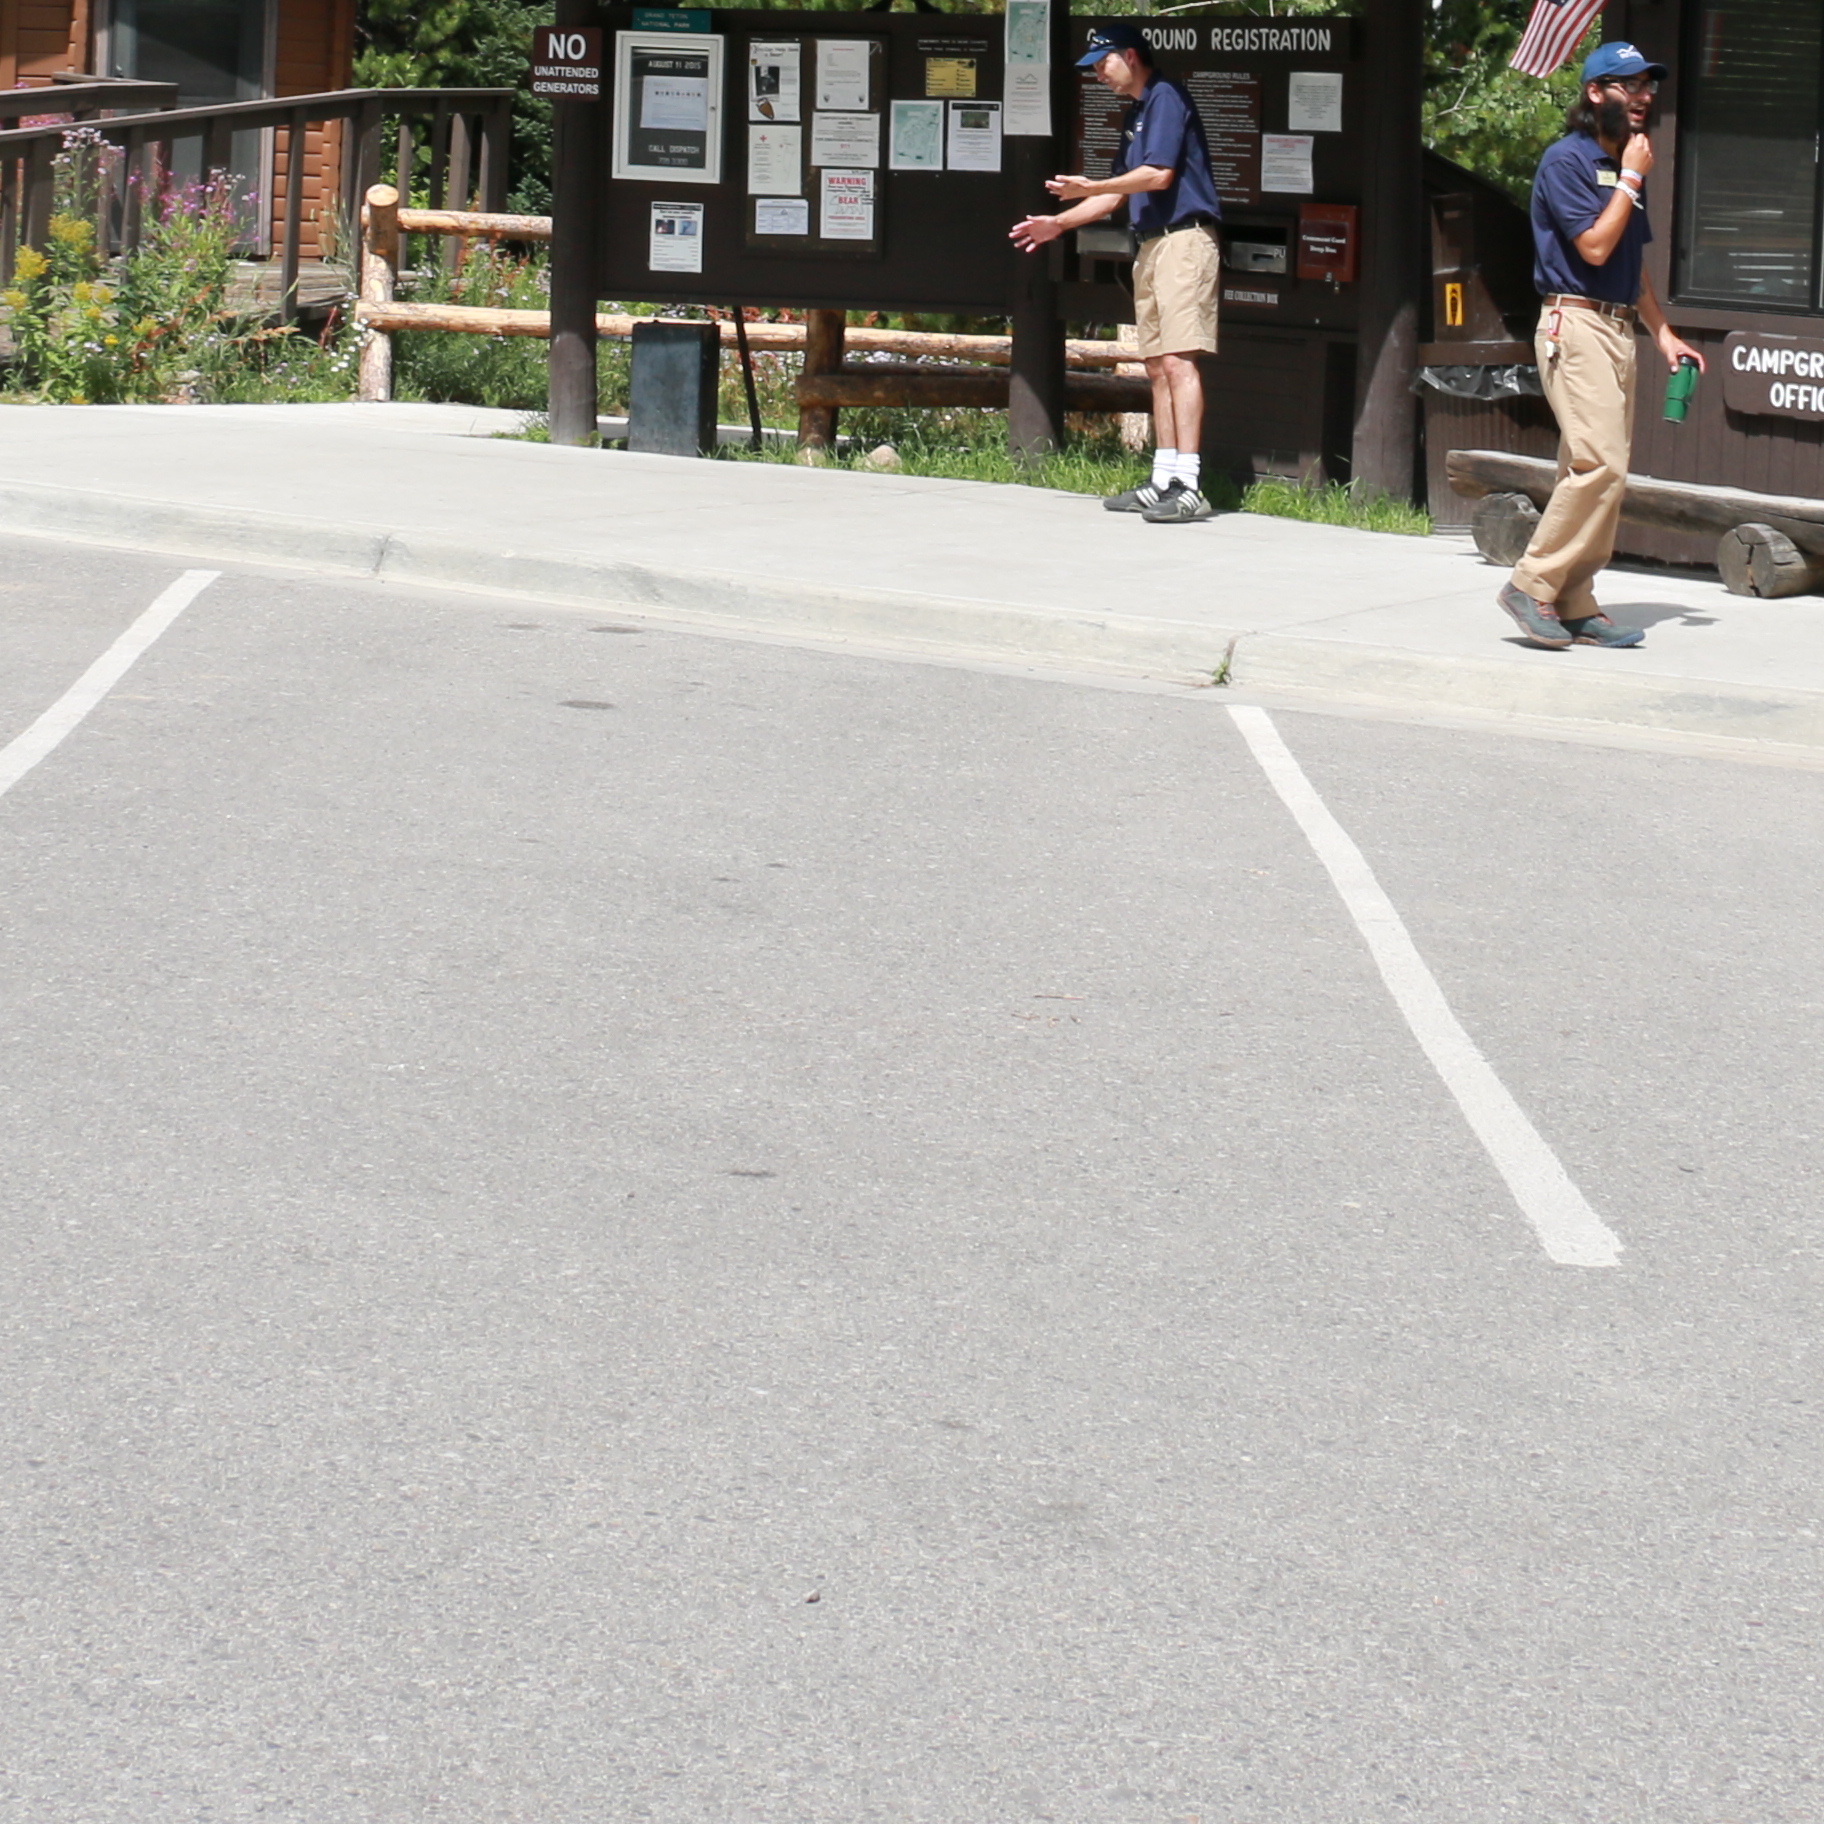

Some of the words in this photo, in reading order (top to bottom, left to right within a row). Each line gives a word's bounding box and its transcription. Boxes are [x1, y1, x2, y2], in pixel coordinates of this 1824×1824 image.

[1211, 28, 1332, 52] REGISTRATION
[548, 33, 587, 60] NO
[648, 60, 674, 69] AUGUST
[534, 65, 599, 79] UNATTENDED
[1232, 72, 1251, 80] RULES
[533, 81, 600, 95] GENERATORS
[648, 144, 666, 153] CALL
[669, 145, 701, 155] DISPATCH
[828, 177, 866, 185] WARNING
[838, 196, 858, 204] BEAR
[1224, 289, 1234, 300] FEE
[1234, 290, 1266, 303] COLLECTION
[1266, 293, 1279, 304] BOX
